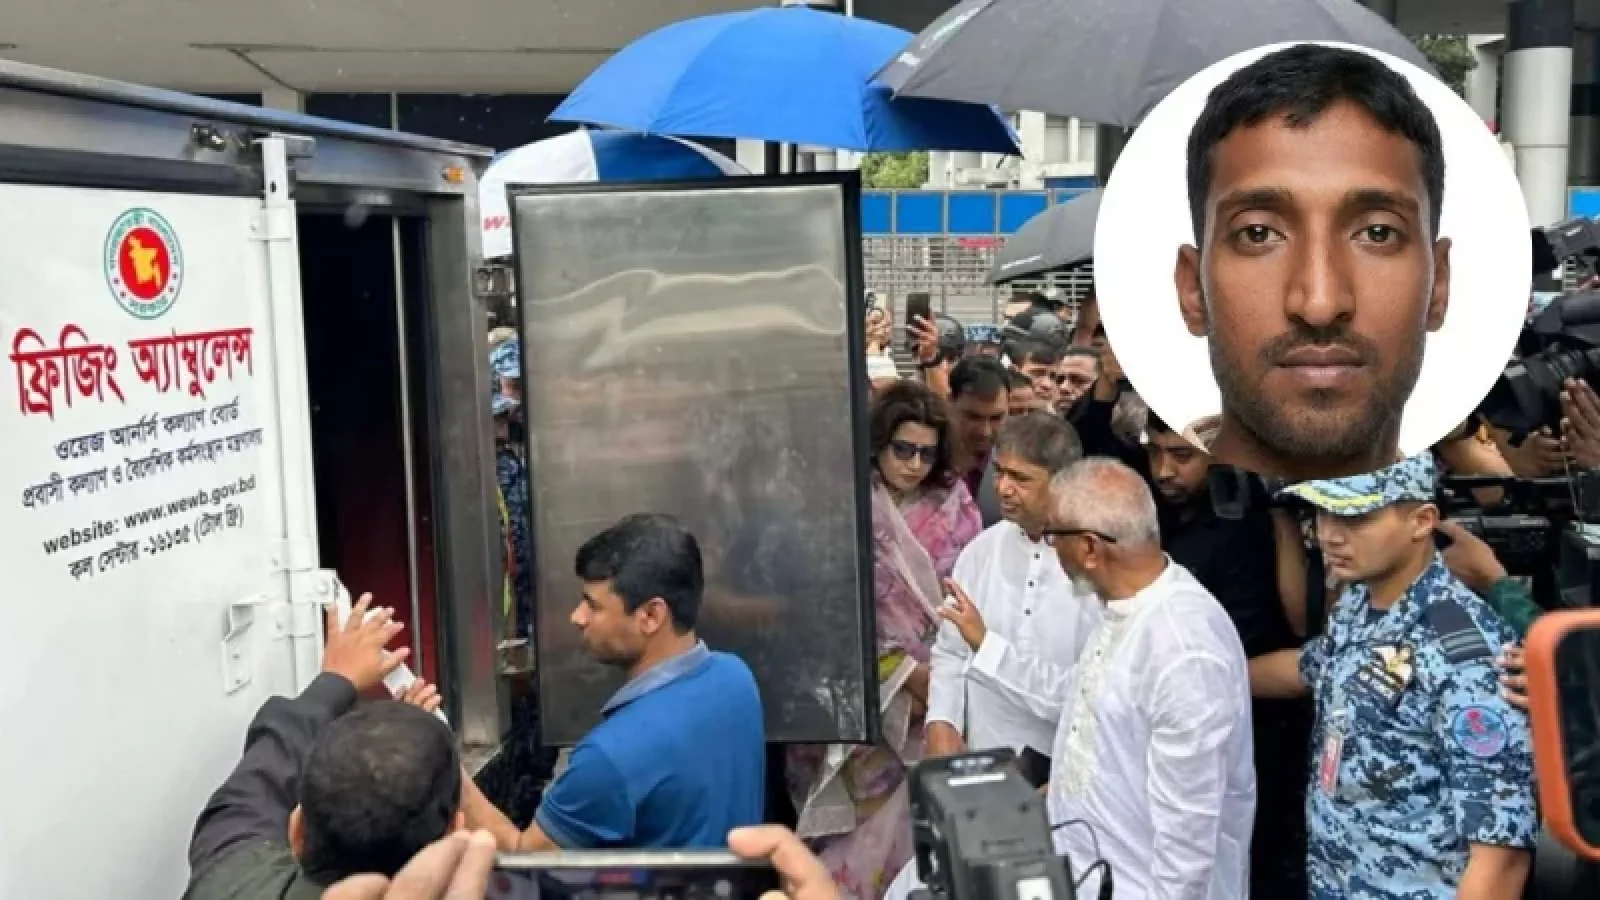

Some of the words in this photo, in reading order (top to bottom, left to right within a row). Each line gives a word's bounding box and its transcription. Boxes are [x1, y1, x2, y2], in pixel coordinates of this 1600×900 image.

[9, 324, 126, 421] ফ্রিজিং
[128, 327, 254, 401] অ্যাম্বুলেন্স
[54, 431, 105, 460] ওয়েজ
[109, 412, 158, 446] আর্নার্স
[210, 395, 239, 425] বোর্ড
[22, 471, 65, 510] প্রবাসী
[112, 464, 122, 484] ও
[42, 519, 120, 555] website:
[123, 473, 257, 529] www.wewb.gov.bd
[68, 555, 94, 582] কল
[98, 539, 140, 573] সেন্টার
